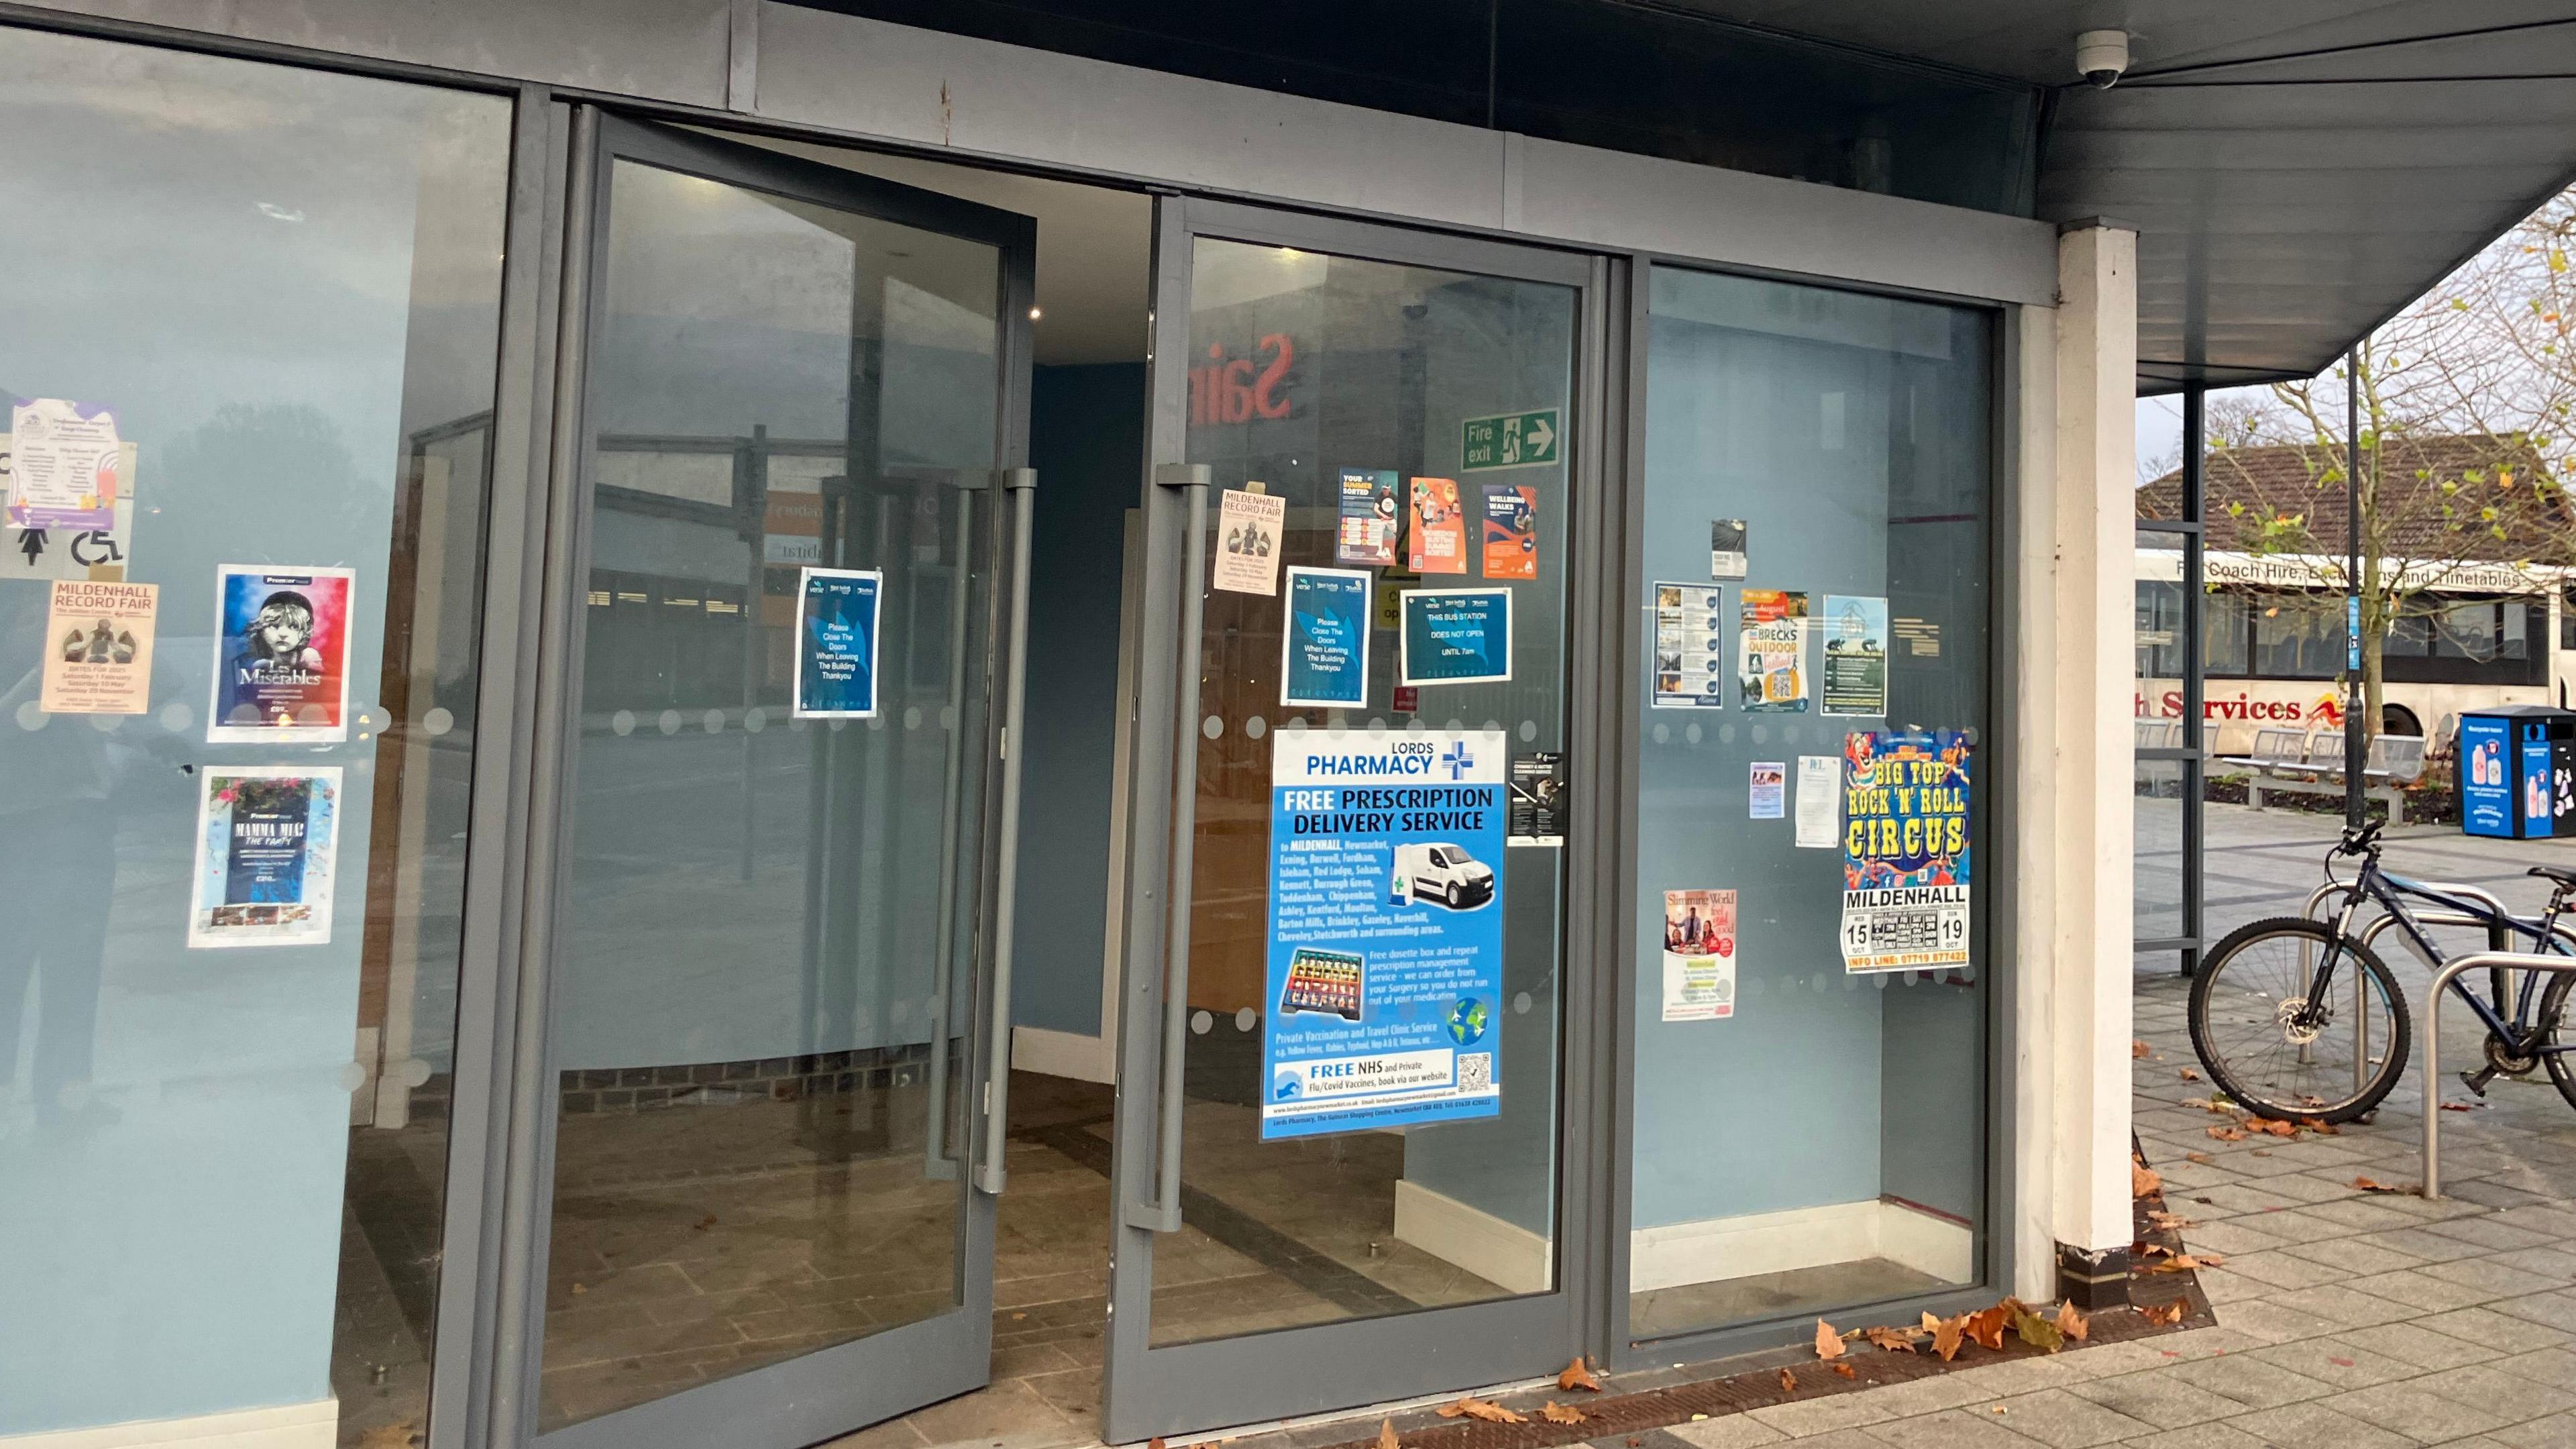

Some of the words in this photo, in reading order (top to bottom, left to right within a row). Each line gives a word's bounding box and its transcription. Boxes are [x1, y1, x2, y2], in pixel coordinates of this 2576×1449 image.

[1468, 424, 1493, 442] Fire
[1468, 445, 1491, 463] exit
[1343, 482, 1373, 490] SUMMER
[1226, 492, 1281, 508] MILDENHALL
[1489, 495, 1525, 504] WELLBEING
[1224, 502, 1259, 514] RECORD
[1262, 506, 1281, 517] FAIR
[2209, 562, 2259, 578] Coach
[2266, 564, 2302, 581] Hire,
[2404, 570, 2430, 584] and
[2435, 570, 2521, 587] Timetables
[57, 584, 151, 598] MILDENHALL
[55, 595, 115, 608] RECORD
[119, 598, 152, 609] FAIR
[1759, 604, 1784, 614] August
[1759, 629, 1797, 641] BRECKS
[829, 643, 847, 651] Doors
[1324, 645, 1348, 655] Leaving
[1749, 641, 1797, 653] OUTDOOR
[836, 653, 859, 661] Leaving
[1321, 655, 1345, 663] Building
[1764, 653, 1791, 671] Festival
[269, 660, 290, 673] Les
[832, 663, 855, 672] Building
[1311, 663, 1340, 673] Thankyou
[822, 672, 851, 680] Thankyou
[2161, 691, 2301, 720] Srvices
[1392, 743, 1434, 754] LORDS
[1307, 755, 1433, 775] PHARMACY
[1876, 763, 1902, 786] BIG
[1911, 762, 1945, 785] TOP
[1284, 790, 1334, 811] FREE
[1342, 788, 1492, 809] PRESCRIPTION
[1848, 789, 1890, 815] ROCK
[1921, 788, 1965, 814] ROLL
[1294, 812, 1395, 834] DELIVERY
[1401, 811, 1483, 831] SERVICE
[235, 823, 275, 837] MAMMA
[280, 822, 304, 837] MIA!
[246, 837, 262, 845] THE
[265, 837, 292, 845] PARTY
[1849, 816, 1965, 857] CIRCUS
[1281, 843, 1289, 852] to
[1290, 839, 1342, 851] MILDENHALL,
[1345, 841, 1389, 851] Newmarket,
[1280, 855, 1307, 865] Exning,
[1309, 853, 1341, 864] Burwell,
[1343, 853, 1377, 863] Fordham,
[1279, 867, 1311, 877] Isleham,
[1313, 867, 1328, 876] Red
[1330, 866, 1354, 877] Lodge,
[1356, 865, 1383, 875] Soham,
[1279, 881, 1311, 891] Kennett,
[1313, 879, 1348, 890] Burrough
[1350, 878, 1374, 888] Green,
[1279, 893, 1325, 903] Tuddenham,
[1329, 892, 1377, 902] Chippenham,
[1668, 894, 1709, 906] Slimming
[1711, 892, 1734, 905] World
[1847, 887, 1966, 908] MILDENHALL
[1279, 906, 1305, 916] Ashley,
[1307, 904, 1342, 914] Kentford,
[1344, 903, 1377, 913] Moulton,
[1711, 906, 1723, 916] feel
[1278, 919, 1303, 929] Barton
[1305, 917, 1326, 928] Mills,
[1327, 916, 1360, 927] Brinkley,
[1362, 915, 1393, 925] Gazeley,
[1394, 912, 1429, 923] Haverhill,
[1360, 928, 1374, 937] and
[1375, 926, 1418, 936] surrounding
[1420, 926, 1444, 934] areas.
[1847, 925, 1867, 945] 15
[1943, 920, 1962, 939] 19
[1453, 946, 1478, 957] repeat
[1369, 961, 1415, 972] prescription
[1417, 958, 1468, 969] management
[1848, 957, 1871, 967] INFO
[1874, 956, 1898, 965] LINE:
[1901, 954, 1929, 963] 07719
[1276, 1032, 1303, 1044] Private
[1305, 1029, 1349, 1042] Vaccination
[1350, 1027, 1364, 1038] and
[1367, 1026, 1389, 1036] Travel
[1391, 1024, 1409, 1034] Clinic
[1411, 1022, 1438, 1033] Service
[1311, 1063, 1354, 1079] FREE
[1358, 1061, 1383, 1075] NHS
[1385, 1064, 1397, 1072] and
[1399, 1062, 1422, 1071] Private
[1309, 1080, 1343, 1093] Flu/Covid
[1344, 1077, 1377, 1089] Vaccines,
[1379, 1075, 1395, 1085] book
[1397, 1075, 1407, 1084] via
[1421, 1071, 1447, 1081] website
[1350, 1111, 1373, 1119] Shopping
